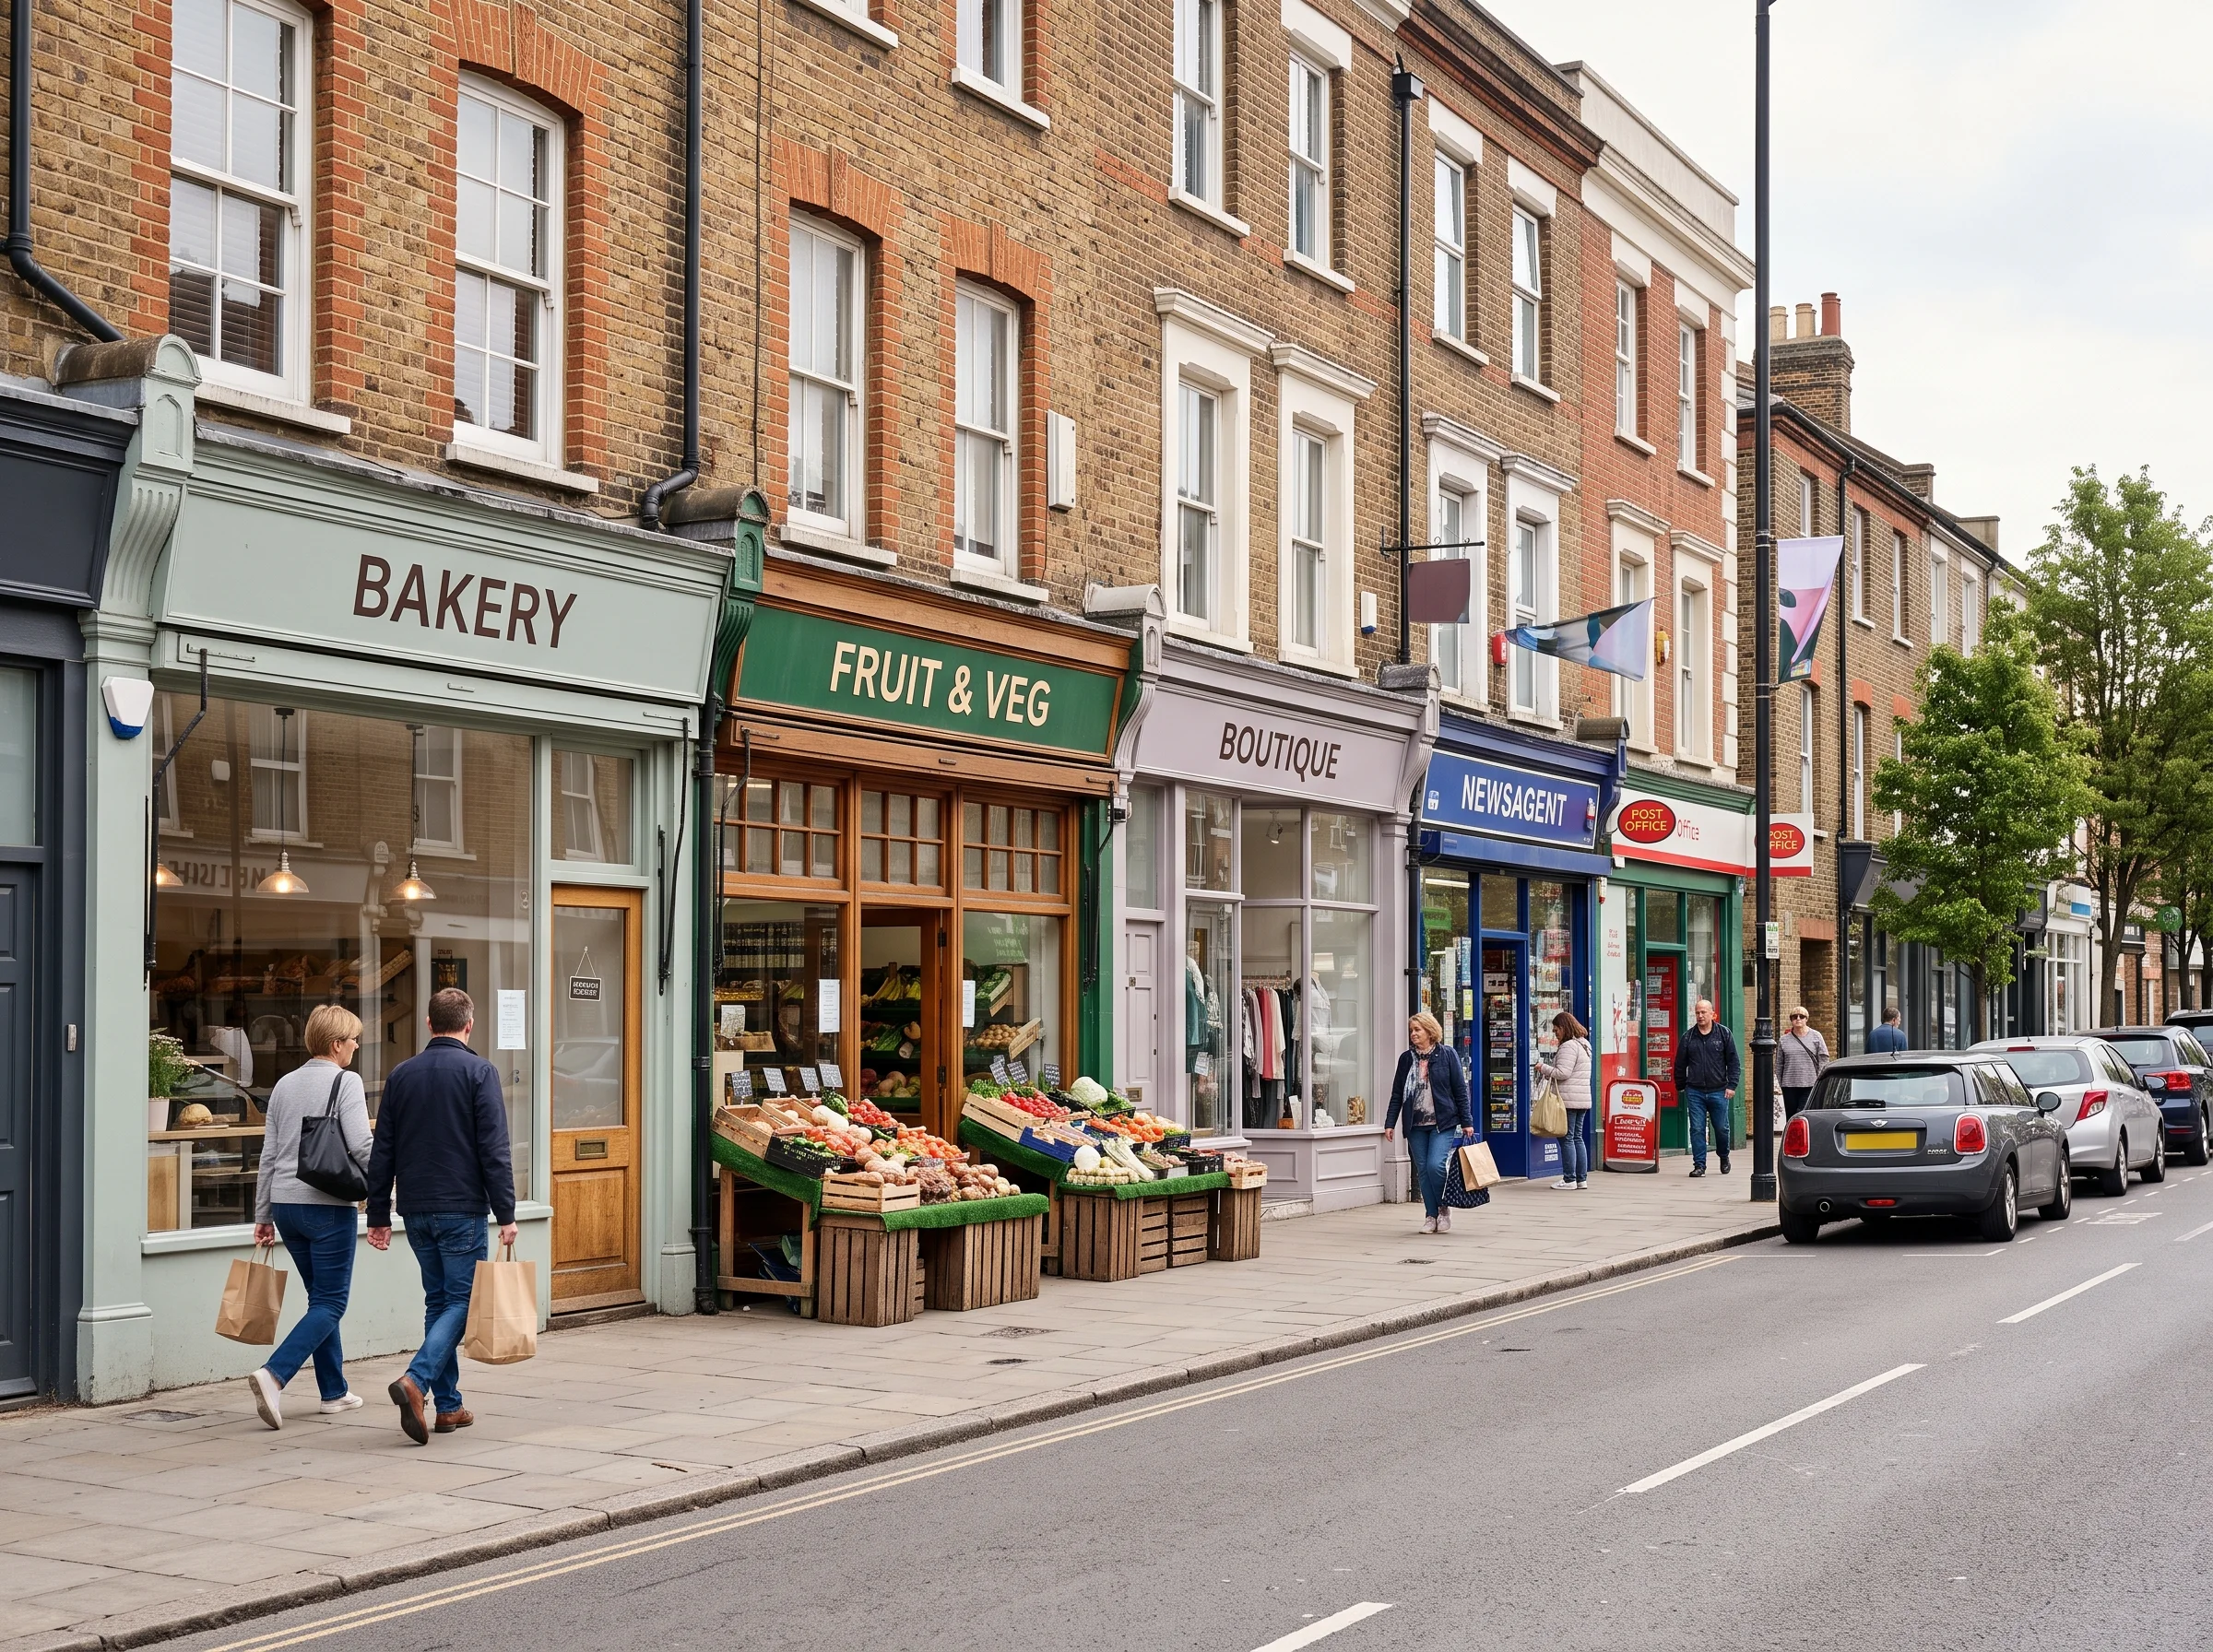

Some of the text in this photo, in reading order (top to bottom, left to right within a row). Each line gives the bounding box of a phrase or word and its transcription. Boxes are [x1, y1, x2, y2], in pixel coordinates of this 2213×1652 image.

[353, 554, 578, 648] BAKERY
[830, 641, 1051, 727] FRUIT & VEG
[1220, 722, 1342, 783] BOUTIQUE
[1462, 773, 1568, 827] NEWSAGENT
[1625, 820, 1667, 832] OFFICE
[1631, 808, 1663, 820] POST
[1769, 840, 1798, 850] FFICE
